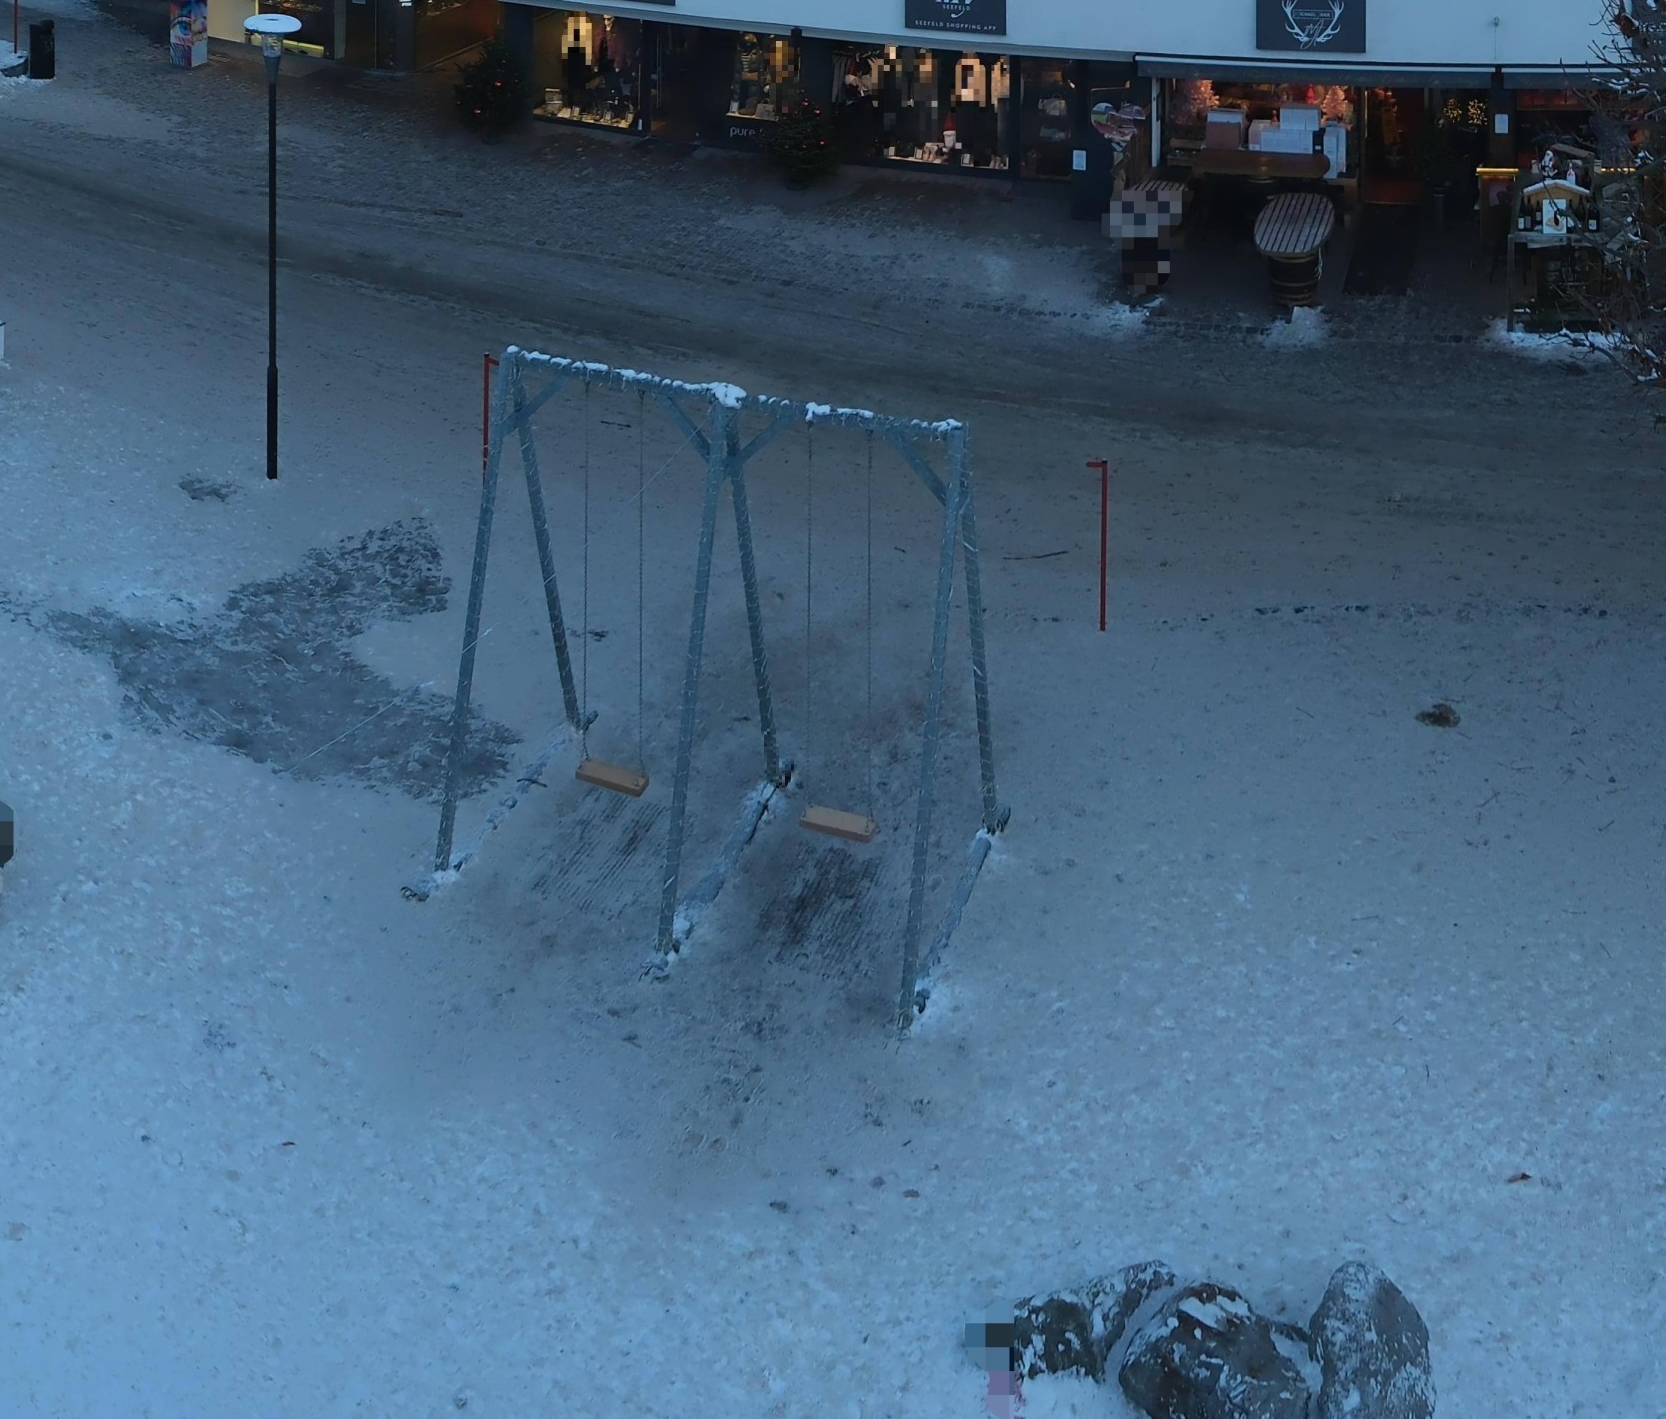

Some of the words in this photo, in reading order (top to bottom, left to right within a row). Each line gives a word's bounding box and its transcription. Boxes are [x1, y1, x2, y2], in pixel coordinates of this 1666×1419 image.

[915, 20, 944, 28] SEEFELD
[946, 22, 981, 30] SHOPPING
[729, 126, 756, 138] pure
